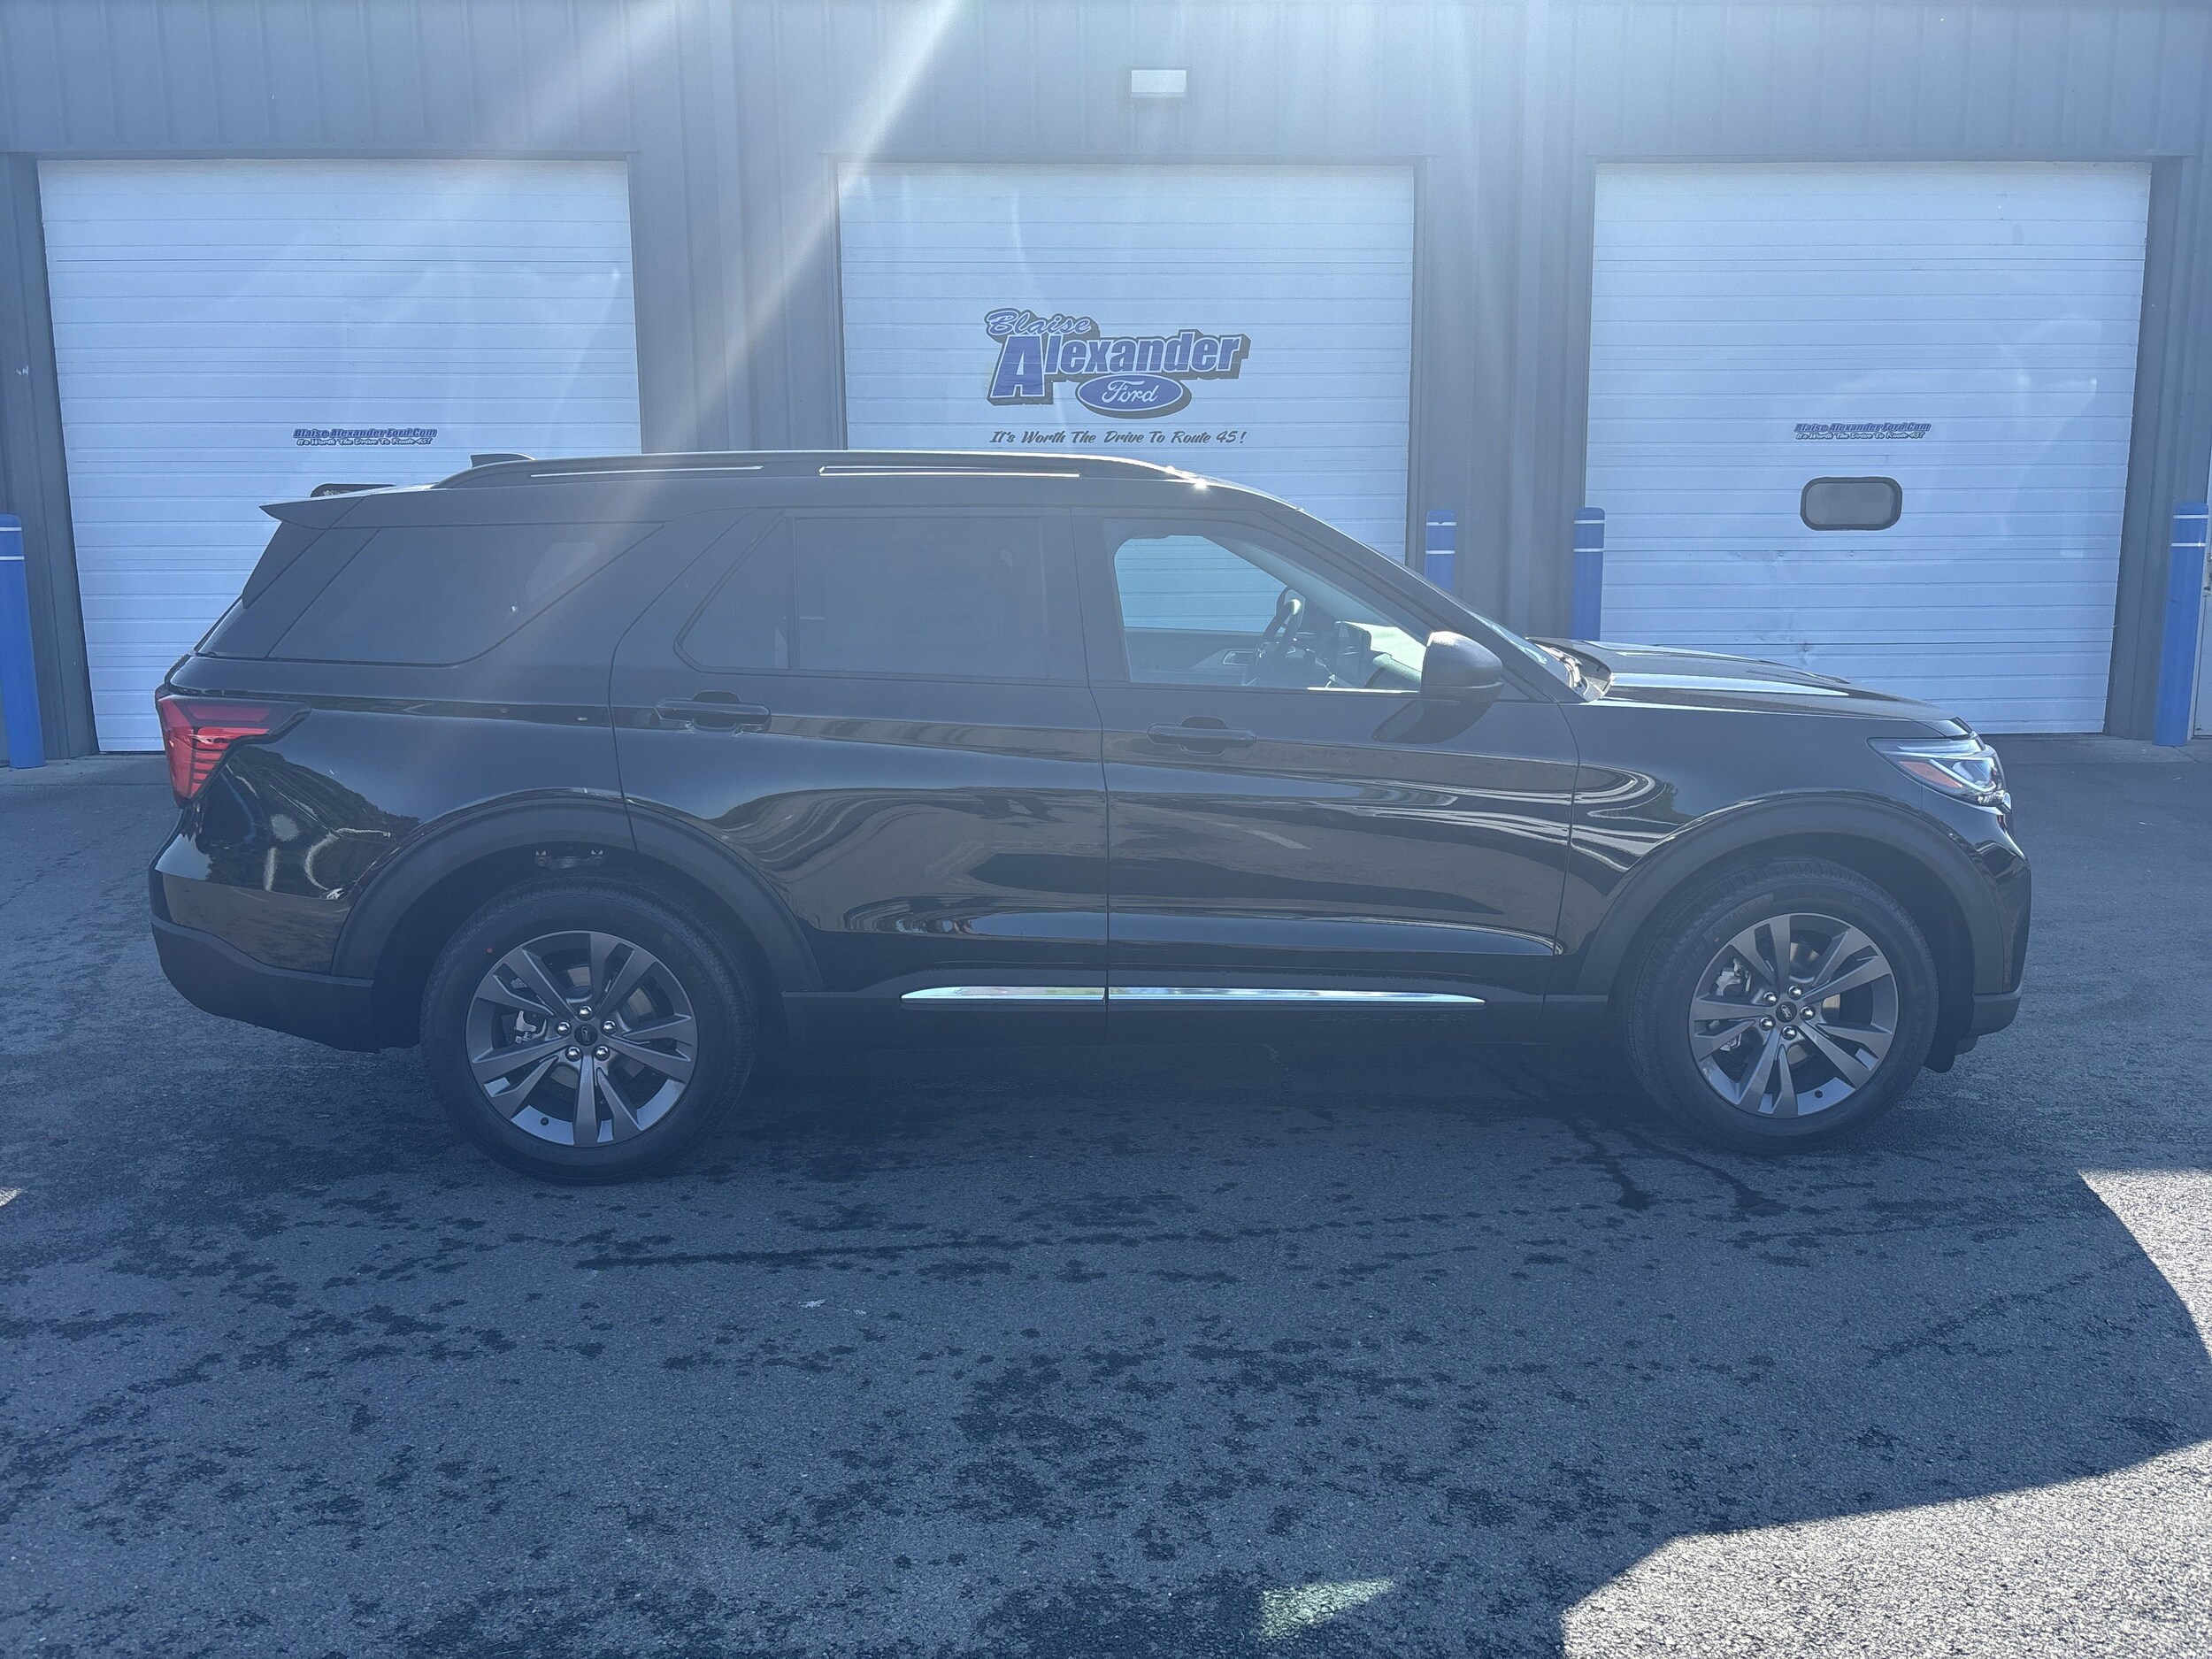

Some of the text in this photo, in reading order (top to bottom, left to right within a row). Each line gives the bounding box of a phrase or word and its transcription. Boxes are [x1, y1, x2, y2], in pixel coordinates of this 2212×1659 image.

[986, 310, 1094, 336] Blaise
[988, 330, 1244, 400] Alexander
[1102, 380, 1159, 403] Ford
[293, 429, 329, 438] Blaise
[989, 431, 1016, 443] It's
[1021, 430, 1065, 443] Worth
[1071, 431, 1097, 443] The
[1103, 431, 1144, 443] Drive
[1149, 431, 1165, 443] To
[1171, 431, 1211, 443] Route
[1793, 423, 1829, 433] Blaise
[1829, 423, 1883, 432] Alexander
